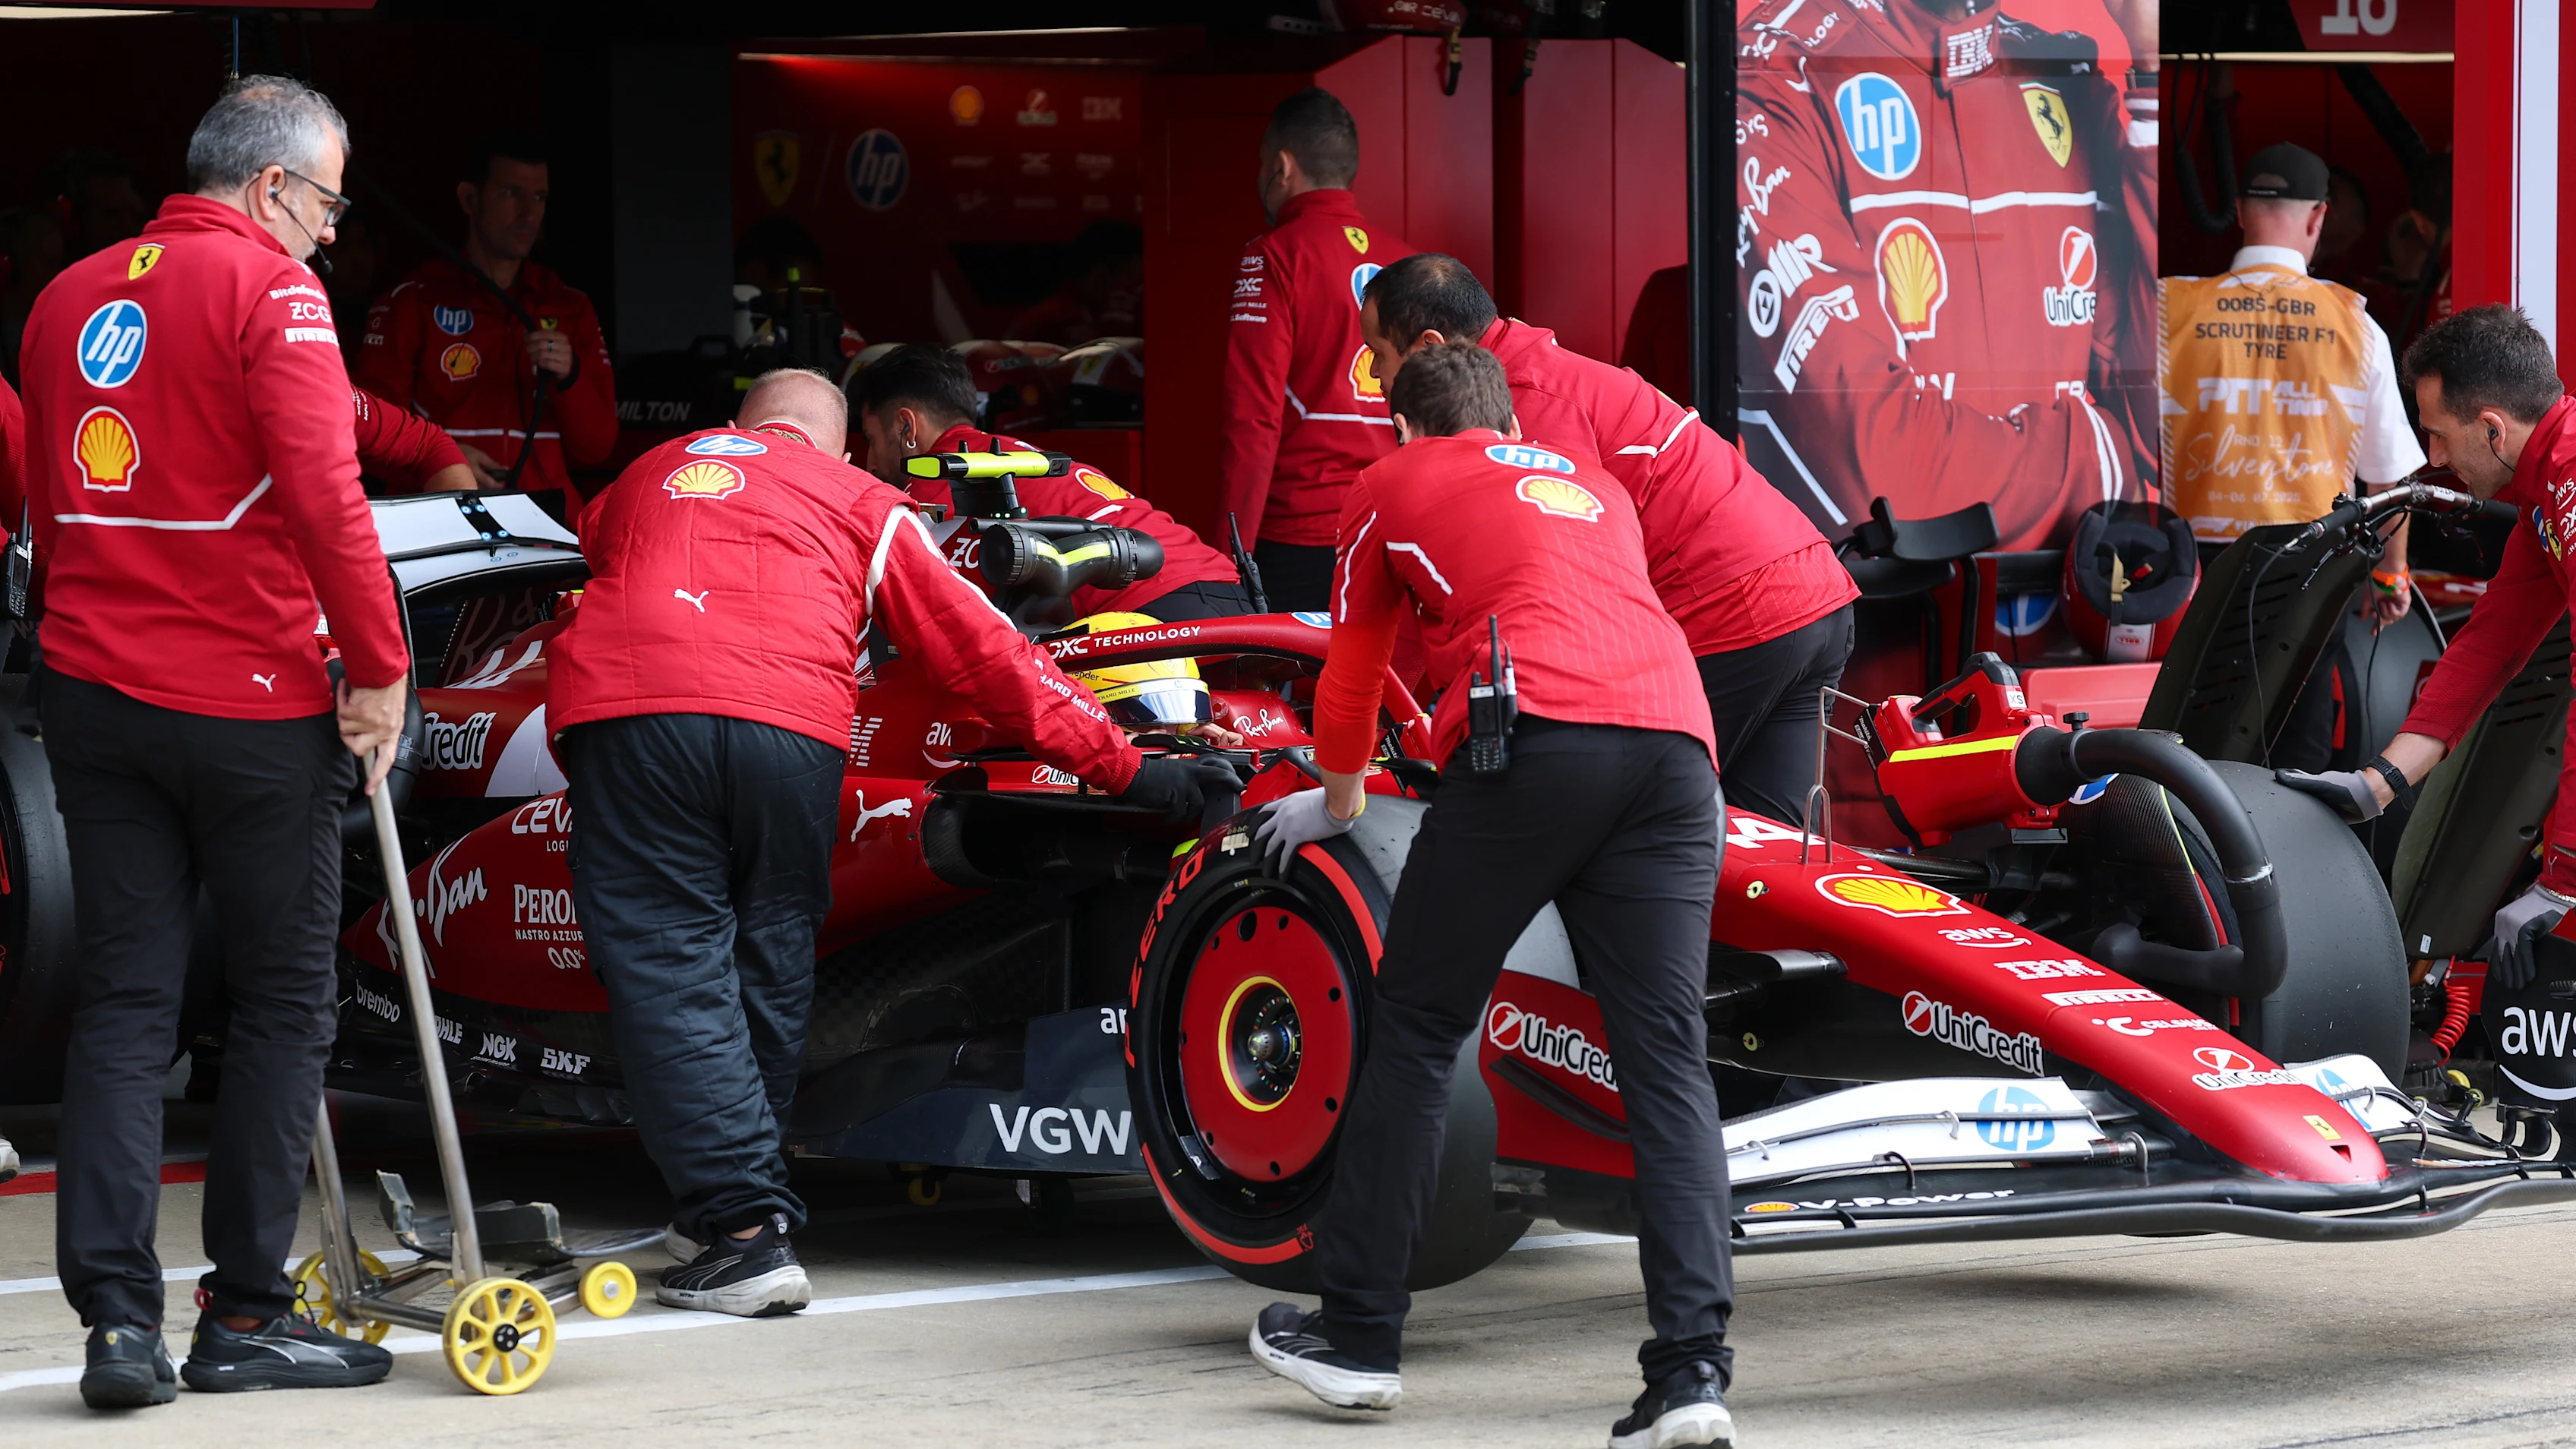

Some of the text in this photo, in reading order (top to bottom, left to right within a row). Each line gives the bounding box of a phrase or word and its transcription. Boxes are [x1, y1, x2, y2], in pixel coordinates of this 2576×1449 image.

[1946, 24, 1994, 78] IBM
[1850, 74, 1907, 179] hp
[854, 131, 901, 210] hp
[1240, 256, 1264, 266] aws
[269, 284, 328, 303] Bitdefend
[441, 305, 467, 333] hp
[2196, 322, 2336, 344] SCRUTINEER F1
[83, 301, 143, 387] hp
[284, 327, 340, 347] PIREL
[2244, 342, 2287, 360] TYRE
[2197, 377, 2271, 415] PIT
[690, 434, 761, 454] hp
[1503, 445, 1564, 473] hp
[2185, 425, 2334, 492] Silverstone
[1048, 626, 1202, 659] DXC TECHNOLOGY
[1118, 687, 1136, 696] MILLE
[2009, 693, 2025, 706] XS
[1070, 694, 1107, 722] MILLE
[926, 722, 952, 747] aw
[1233, 708, 1285, 739] Ray-Ban
[423, 715, 492, 767] Credit
[515, 929, 551, 941] NASTRO
[1129, 846, 1206, 1009] ZERO
[1937, 927, 2016, 943] aws
[1994, 958, 2107, 981] IBM
[355, 979, 401, 1023] brembo
[2041, 988, 2164, 1007] PIRELLI
[435, 1015, 464, 1045] AHLE
[1100, 1007, 1127, 1034] ar
[2502, 1006, 2576, 1058] aw
[479, 1031, 518, 1062] NGK
[1934, 1002, 2043, 1075] UniCredit
[540, 1047, 591, 1075] SKF
[2195, 1068, 2303, 1089] UniCredit
[989, 1103, 1132, 1156] VGW
[1988, 1086, 2048, 1152] hp
[1798, 1188, 2016, 1211] V-Power
